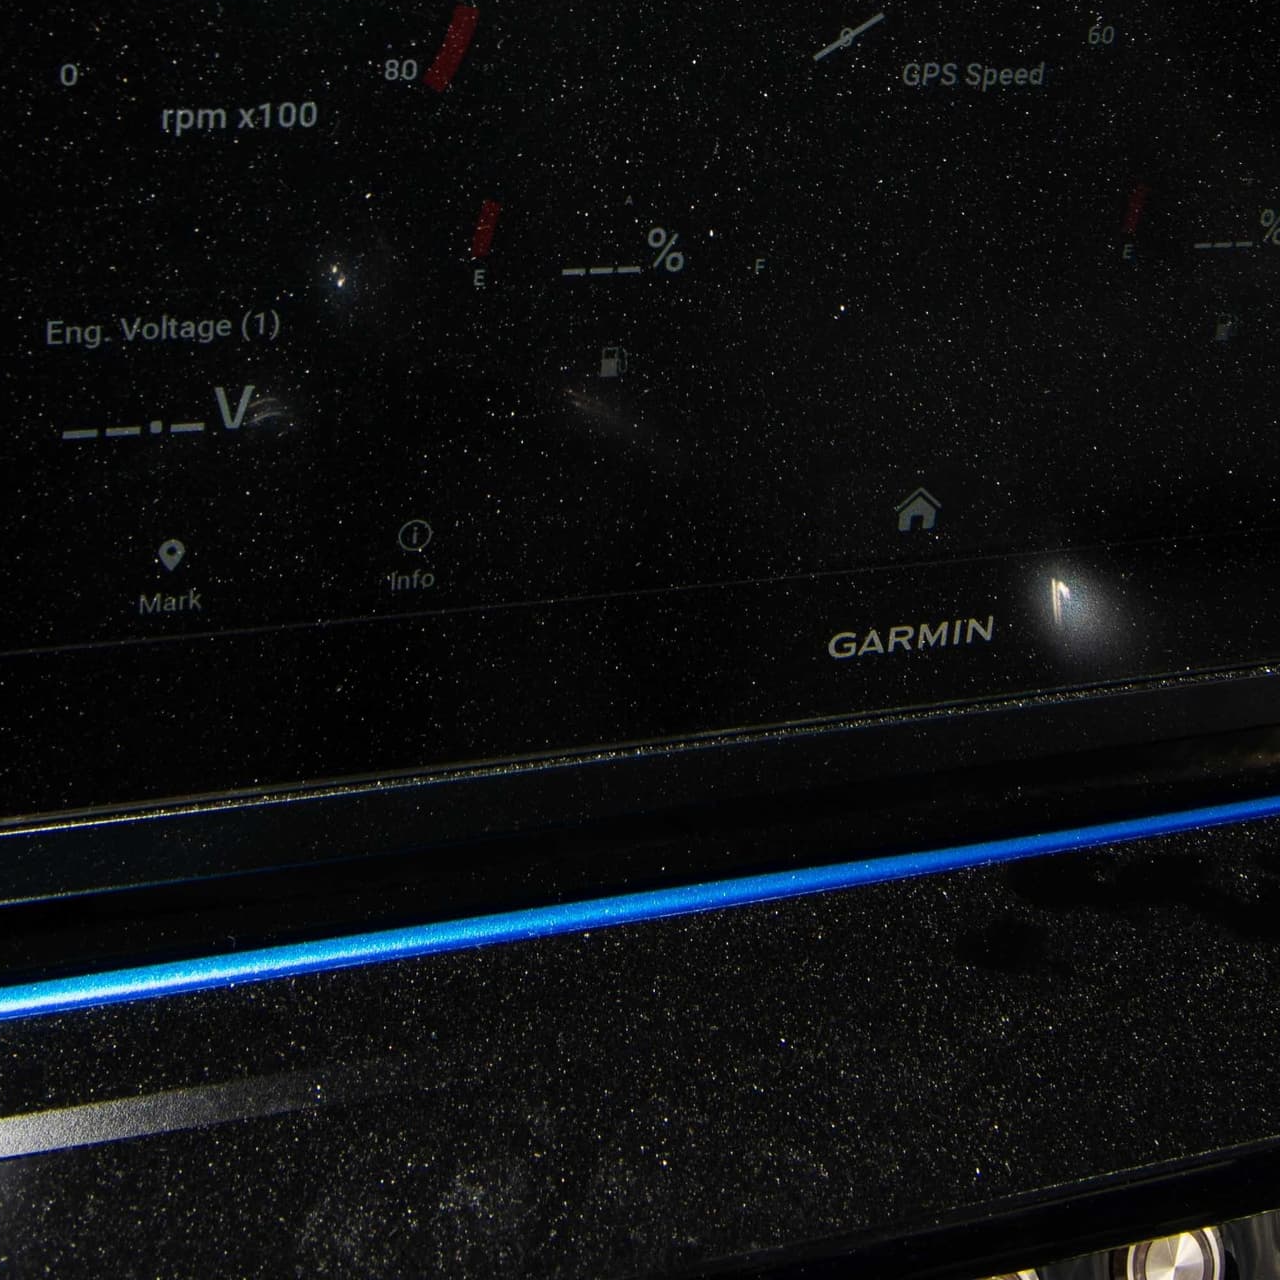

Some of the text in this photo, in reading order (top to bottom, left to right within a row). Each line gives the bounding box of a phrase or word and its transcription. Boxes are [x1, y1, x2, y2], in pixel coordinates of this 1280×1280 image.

[1087, 25, 1116, 46] 60
[59, 64, 79, 88] 0
[384, 59, 419, 82] 80
[902, 61, 1045, 92] GPS Speed
[161, 102, 318, 136] rpm x100
[473, 269, 487, 287] E
[755, 258, 767, 274] F
[47, 309, 281, 349] Eng. Voltage (1)
[214, 384, 256, 430] V
[390, 568, 436, 592] Info
[138, 588, 203, 615] Mark
[828, 615, 994, 659] GARMIN
